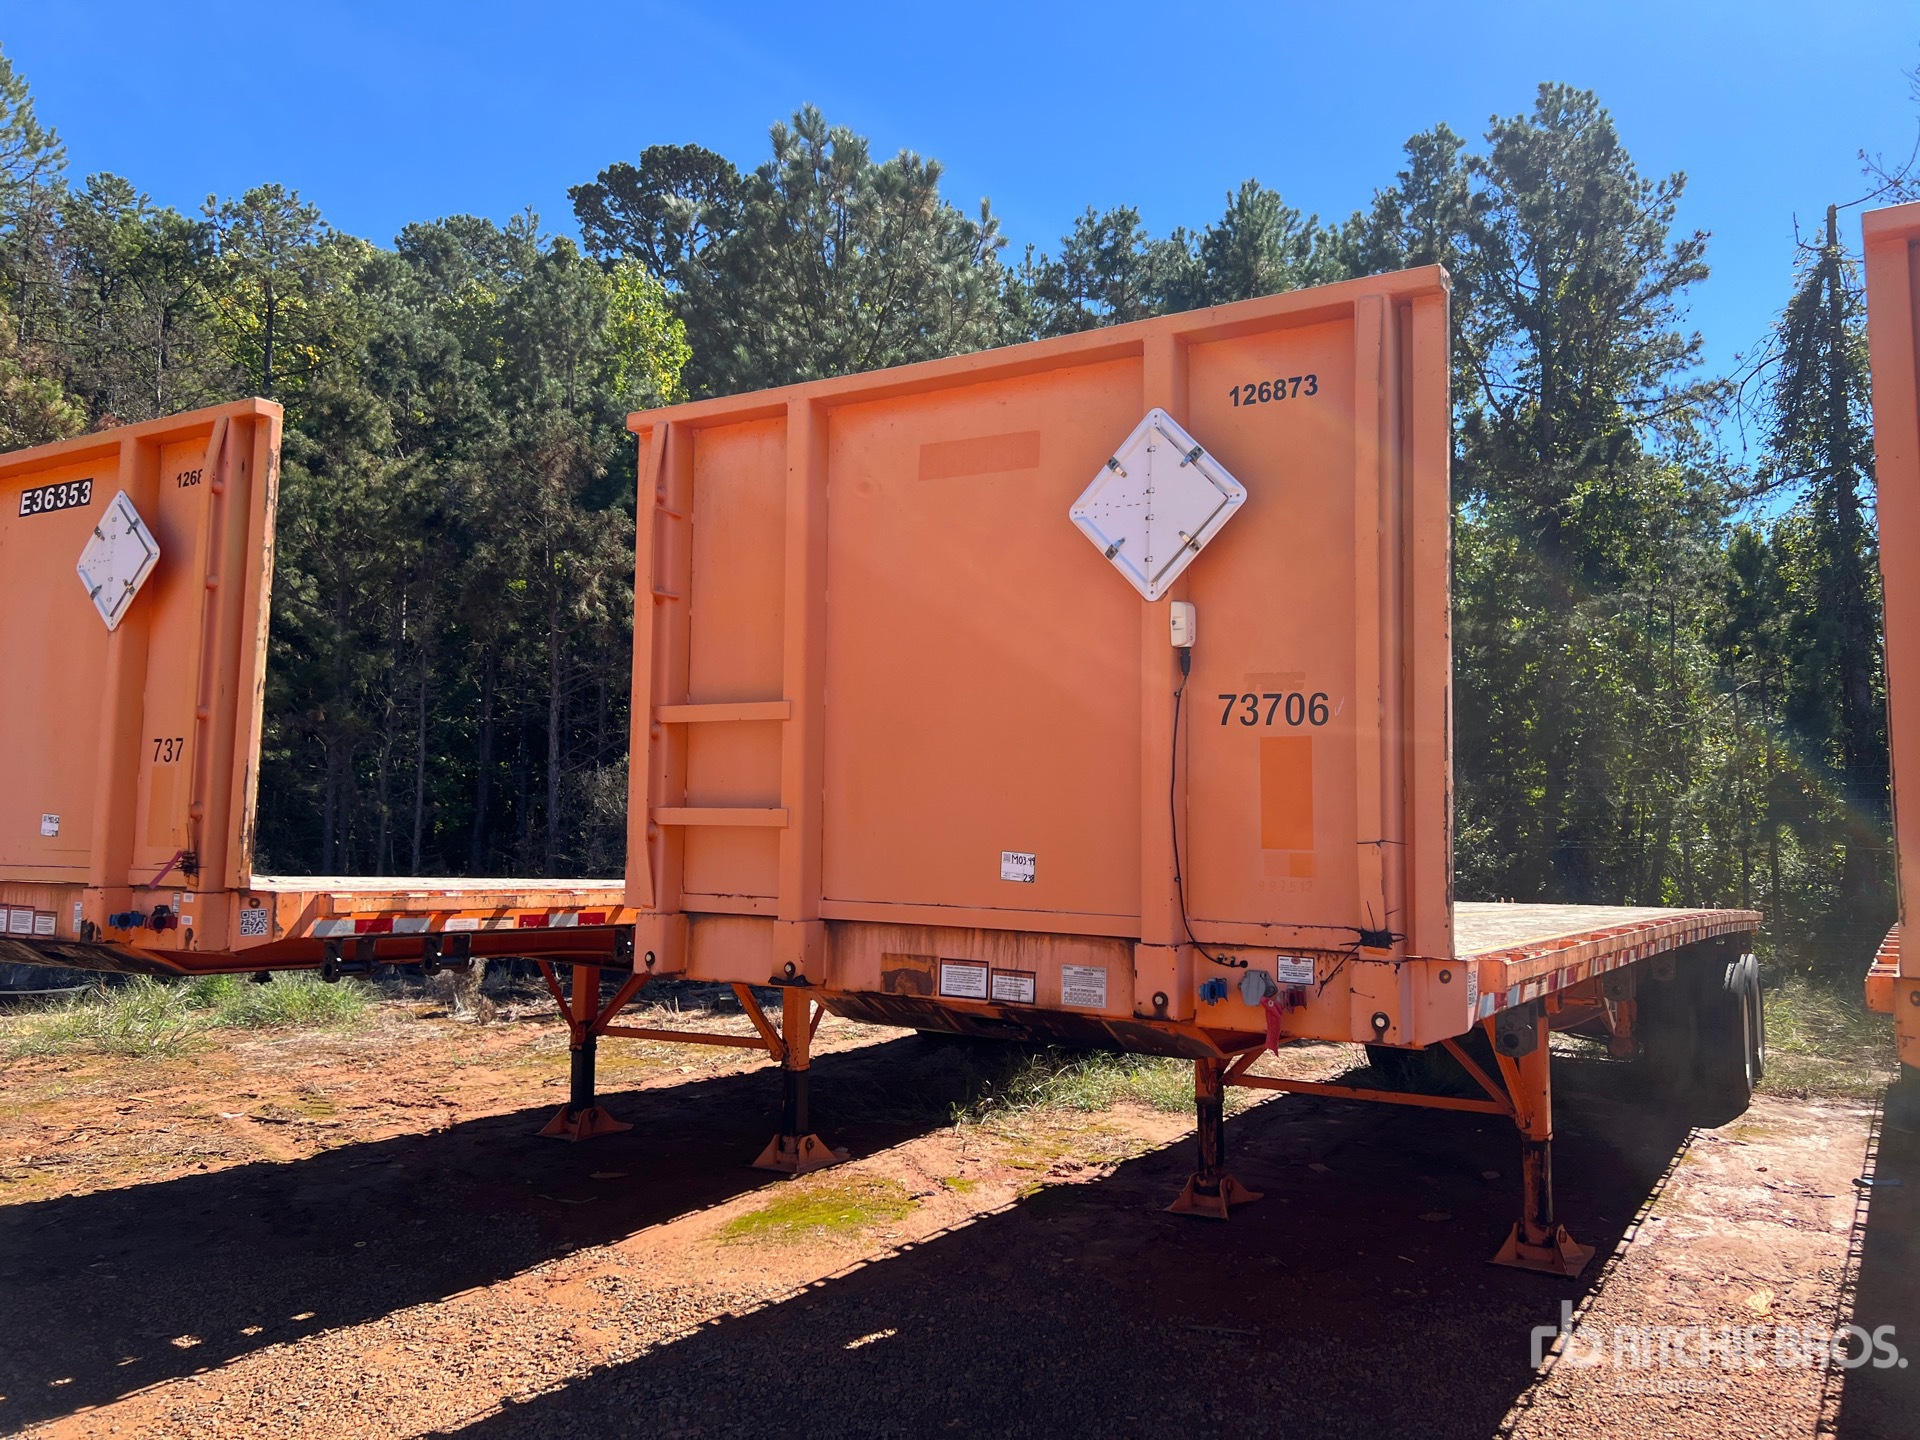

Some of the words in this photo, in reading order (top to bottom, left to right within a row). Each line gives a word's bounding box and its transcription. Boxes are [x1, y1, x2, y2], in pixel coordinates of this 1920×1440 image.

[1229, 374, 1319, 408] 126873
[20, 481, 92, 515] E36353
[1218, 692, 1330, 727] 73706
[153, 738, 184, 763] 737
